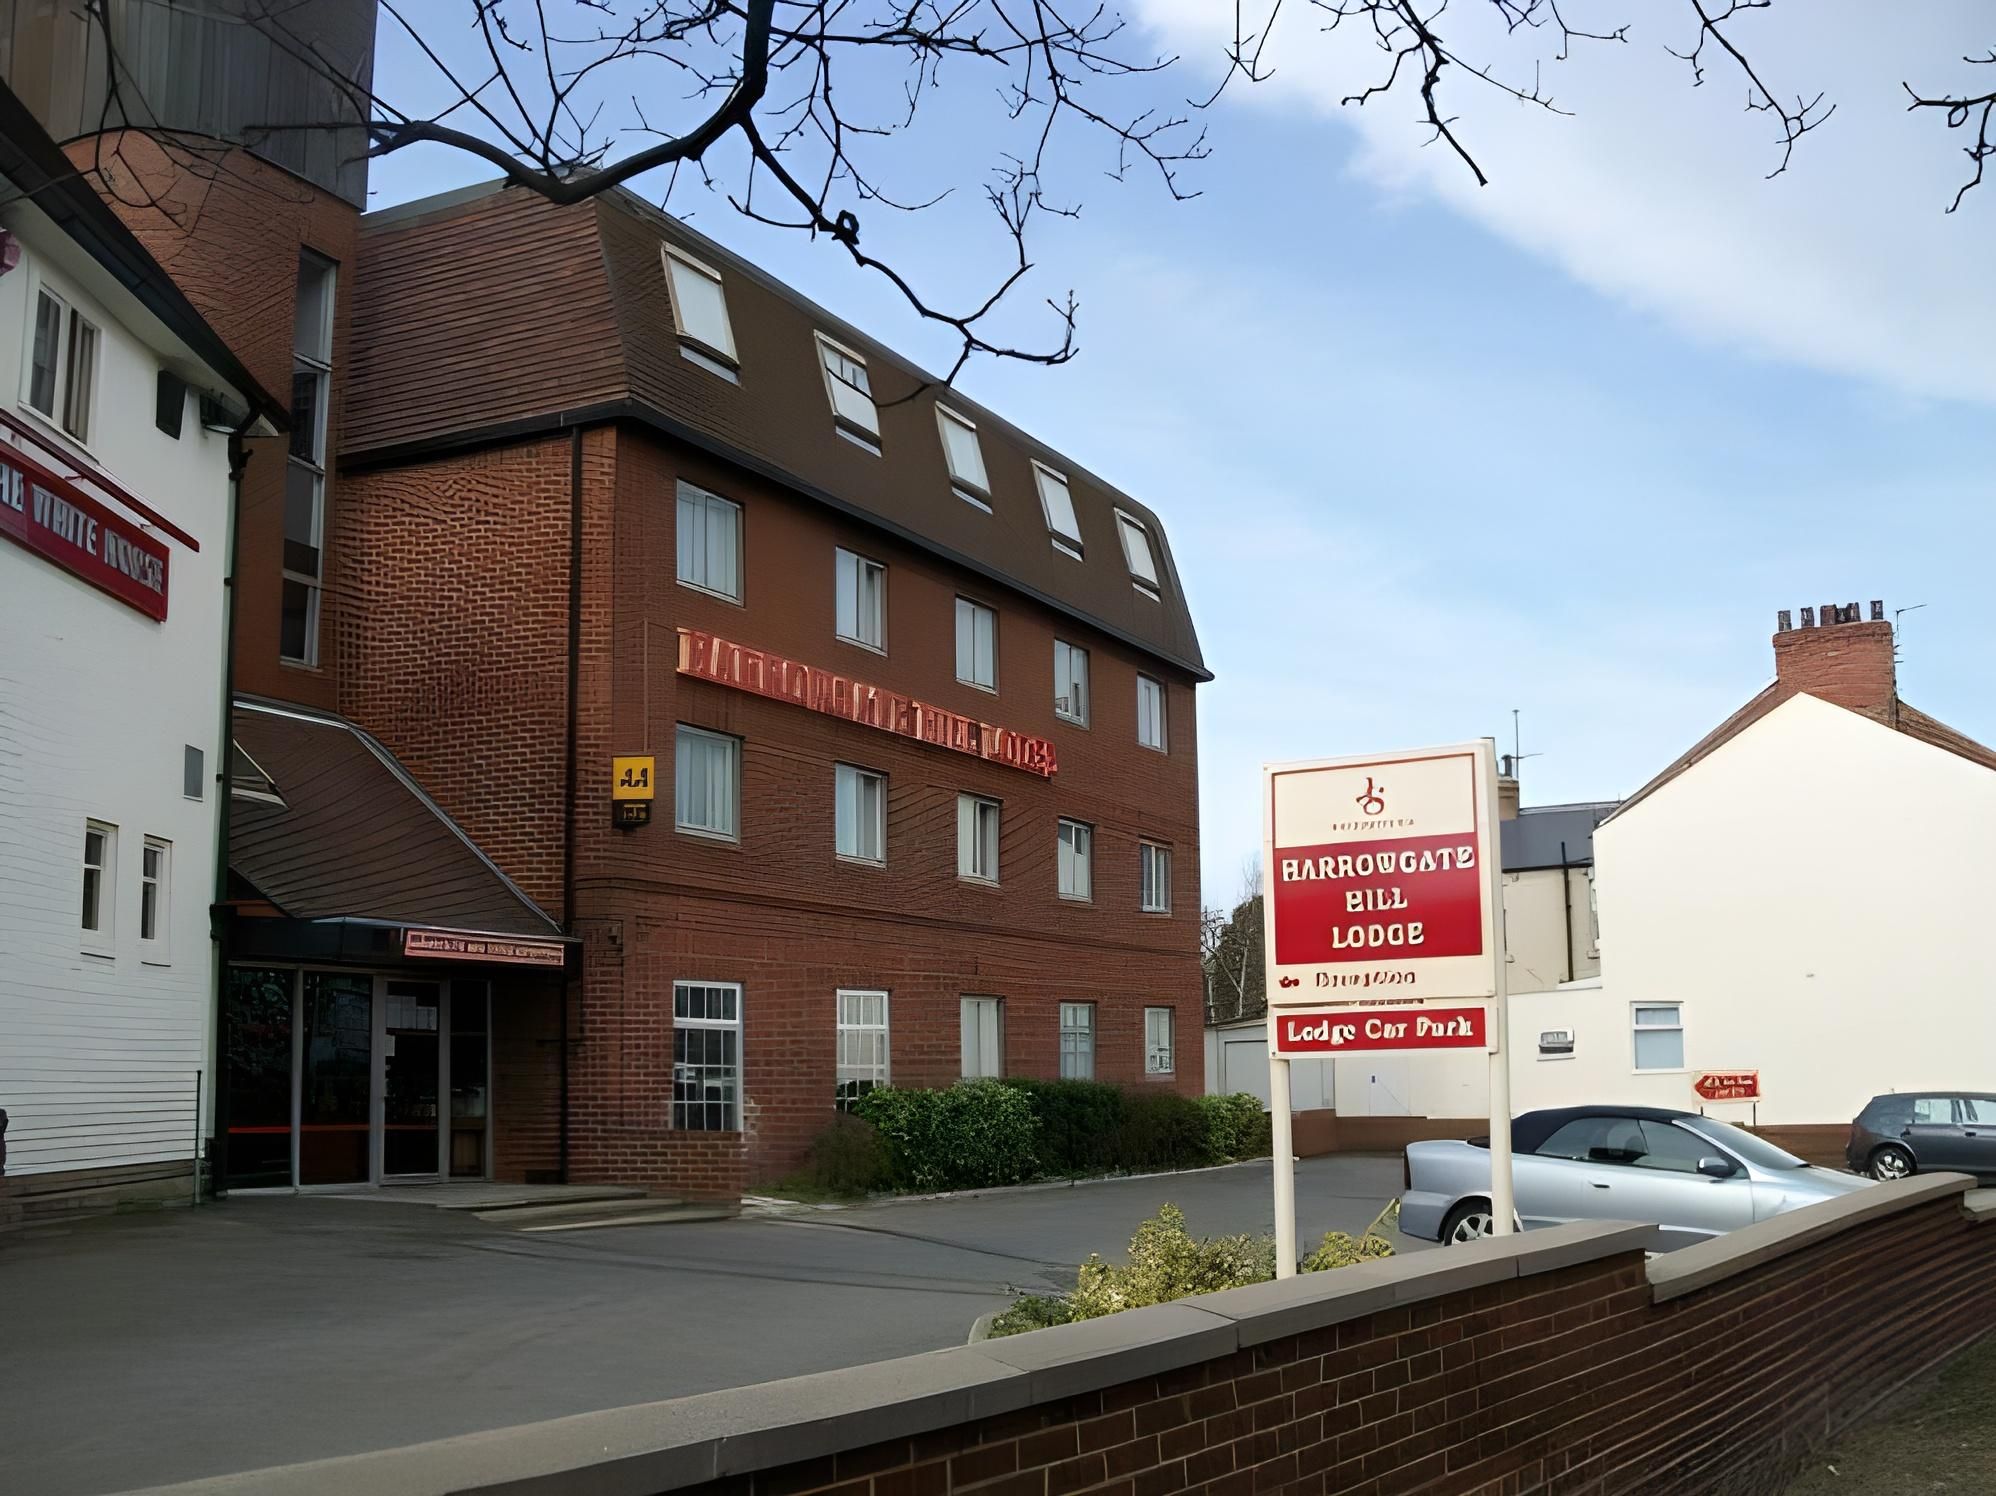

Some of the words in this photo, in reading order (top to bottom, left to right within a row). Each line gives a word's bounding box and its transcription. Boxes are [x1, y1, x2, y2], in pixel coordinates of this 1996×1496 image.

[1282, 846, 1475, 881] HARROWGATE
[1332, 922, 1424, 949] LODGE
[1287, 1020, 1355, 1045] Lodge
